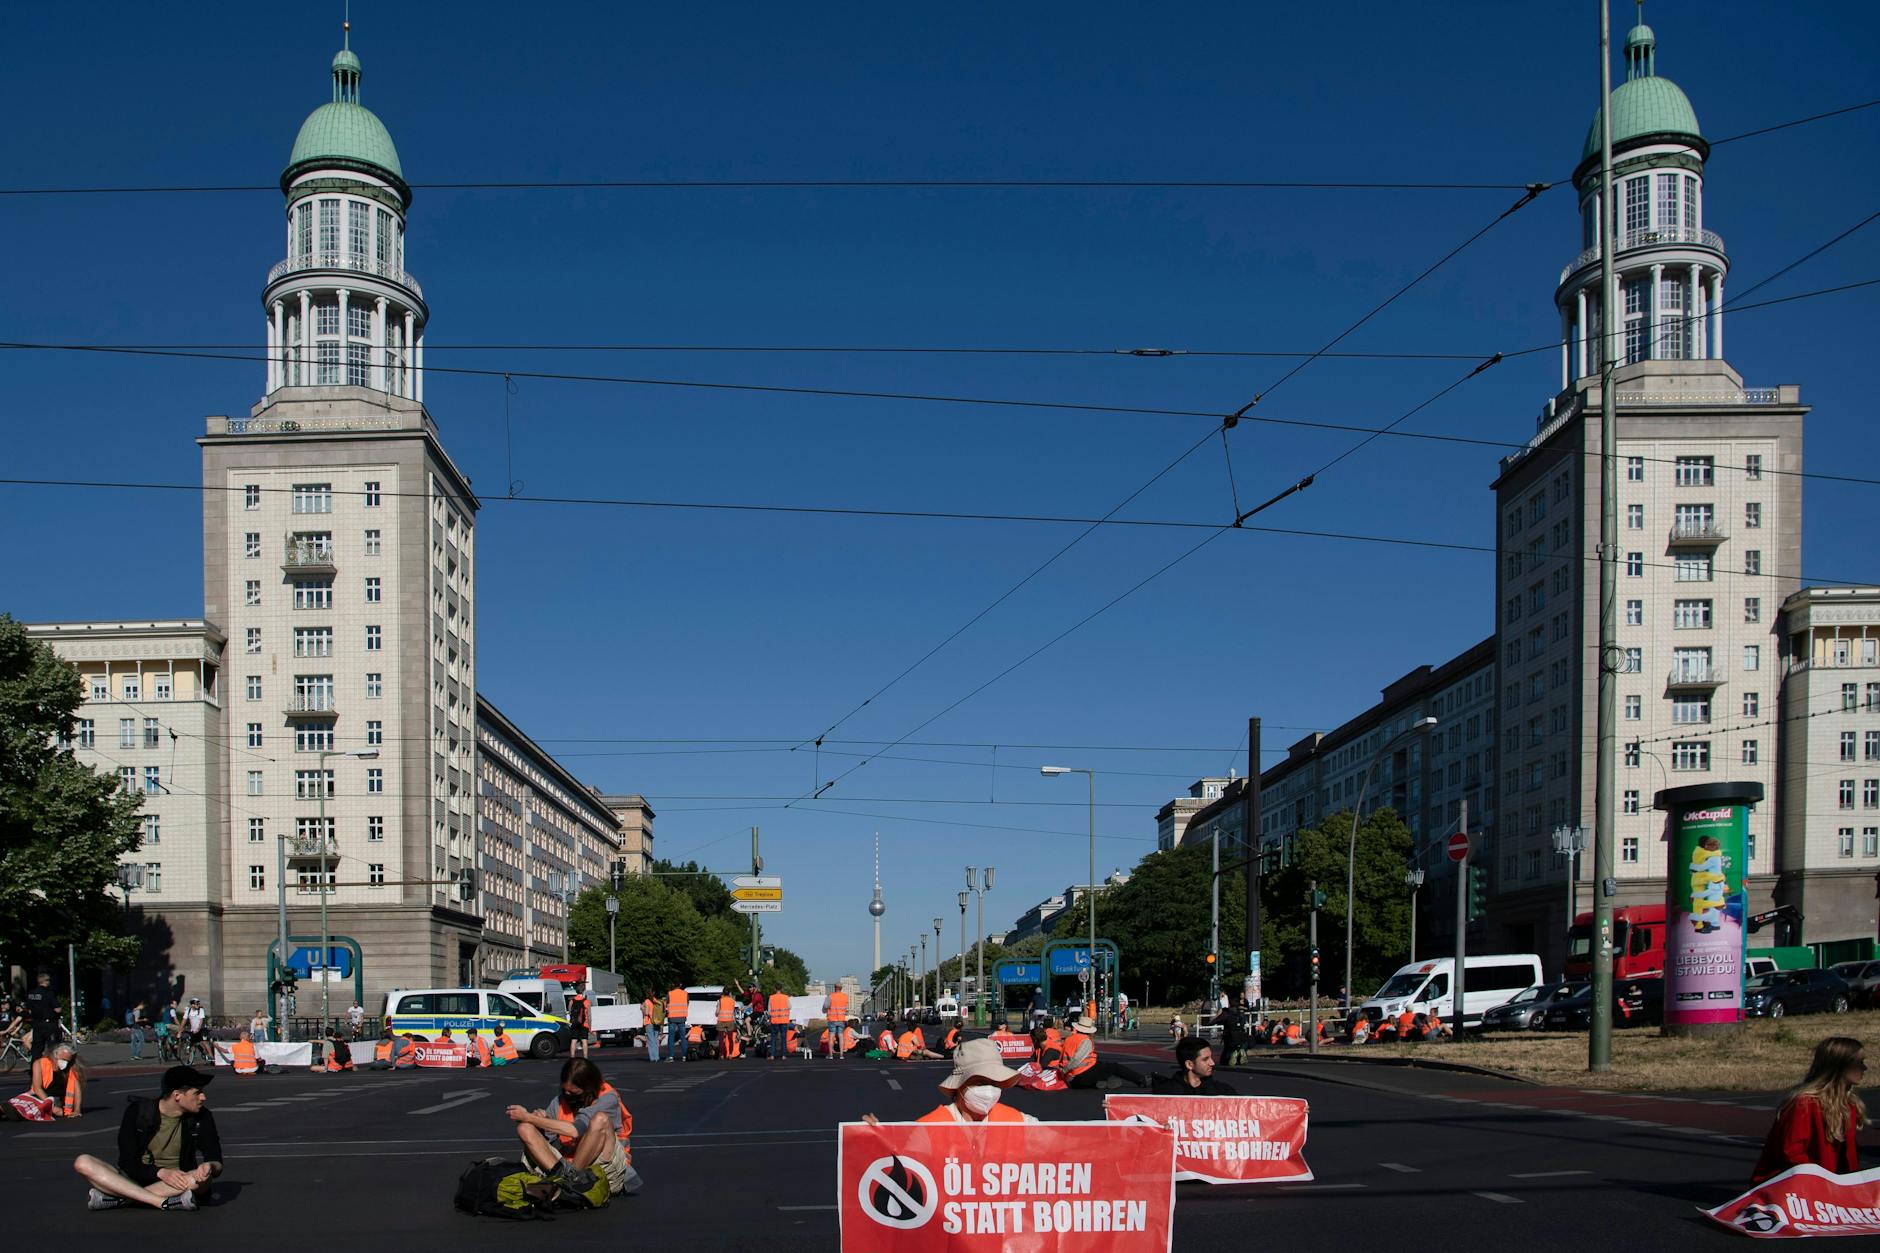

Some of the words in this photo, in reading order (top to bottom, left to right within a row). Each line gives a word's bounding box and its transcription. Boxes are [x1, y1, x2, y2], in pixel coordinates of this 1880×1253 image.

[1683, 807, 1732, 821] OkCupid
[308, 951, 319, 965] U
[1676, 954, 1735, 966] LIEBEVOLL
[1016, 967, 1025, 976] U
[1691, 966, 1715, 975] WIE
[1717, 965, 1736, 975] DU!
[1191, 1120, 1260, 1138] SPAREN
[1225, 1141, 1290, 1160] BOHREN
[943, 1157, 976, 1196] ÖL
[982, 1162, 1092, 1196] SPAREN
[1786, 1193, 1814, 1221] ÖL
[943, 1202, 1026, 1234] STATT
[1033, 1200, 1147, 1232] BOHREN
